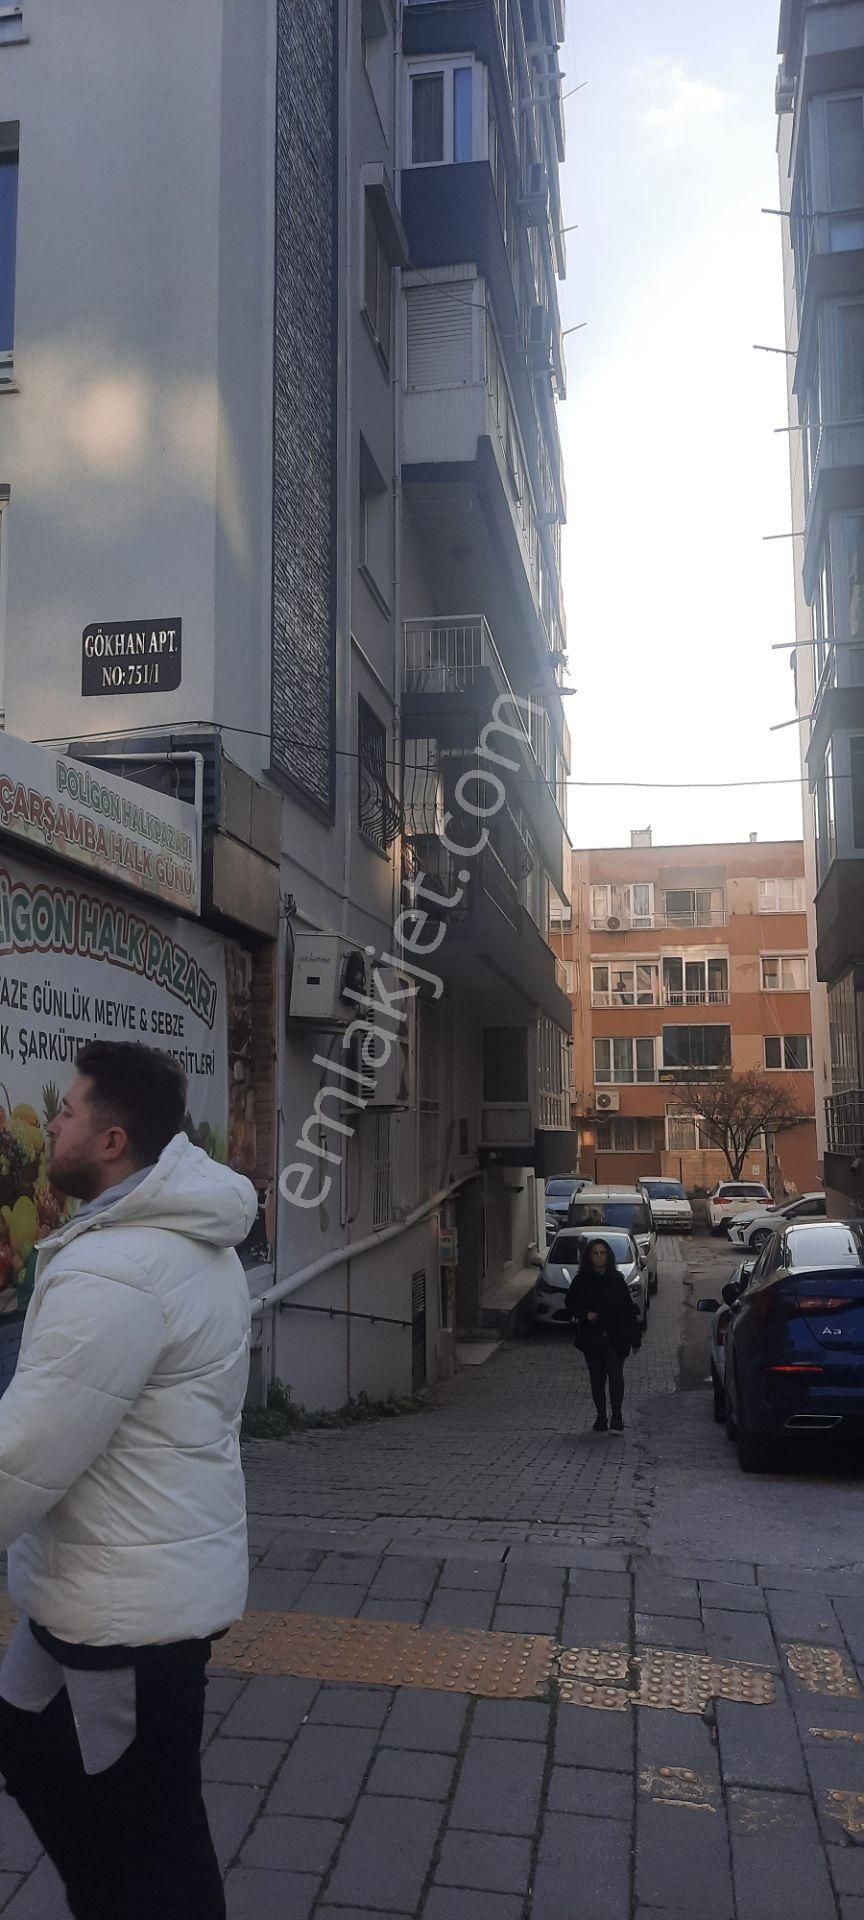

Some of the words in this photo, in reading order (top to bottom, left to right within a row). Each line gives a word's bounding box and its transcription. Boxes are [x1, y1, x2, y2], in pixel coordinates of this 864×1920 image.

[84, 628, 146, 658] GÖKHAN
[148, 630, 178, 653] APT.
[102, 665, 126, 687] NO:
[128, 663, 159, 686] 751/1
[56, 760, 122, 823] POLİGON
[0, 773, 110, 860] ÇARŞAMBA
[109, 830, 154, 880] HALK
[155, 853, 196, 899] GÜNÜ
[79, 900, 146, 970] HALK
[0, 976, 28, 1011] AZE
[33, 980, 91, 1023] GÜNLÜK
[94, 998, 136, 1030] MEYVE
[140, 1007, 148, 1032] &
[151, 1010, 184, 1038] SEBZE
[822, 1326, 842, 1335] A3
